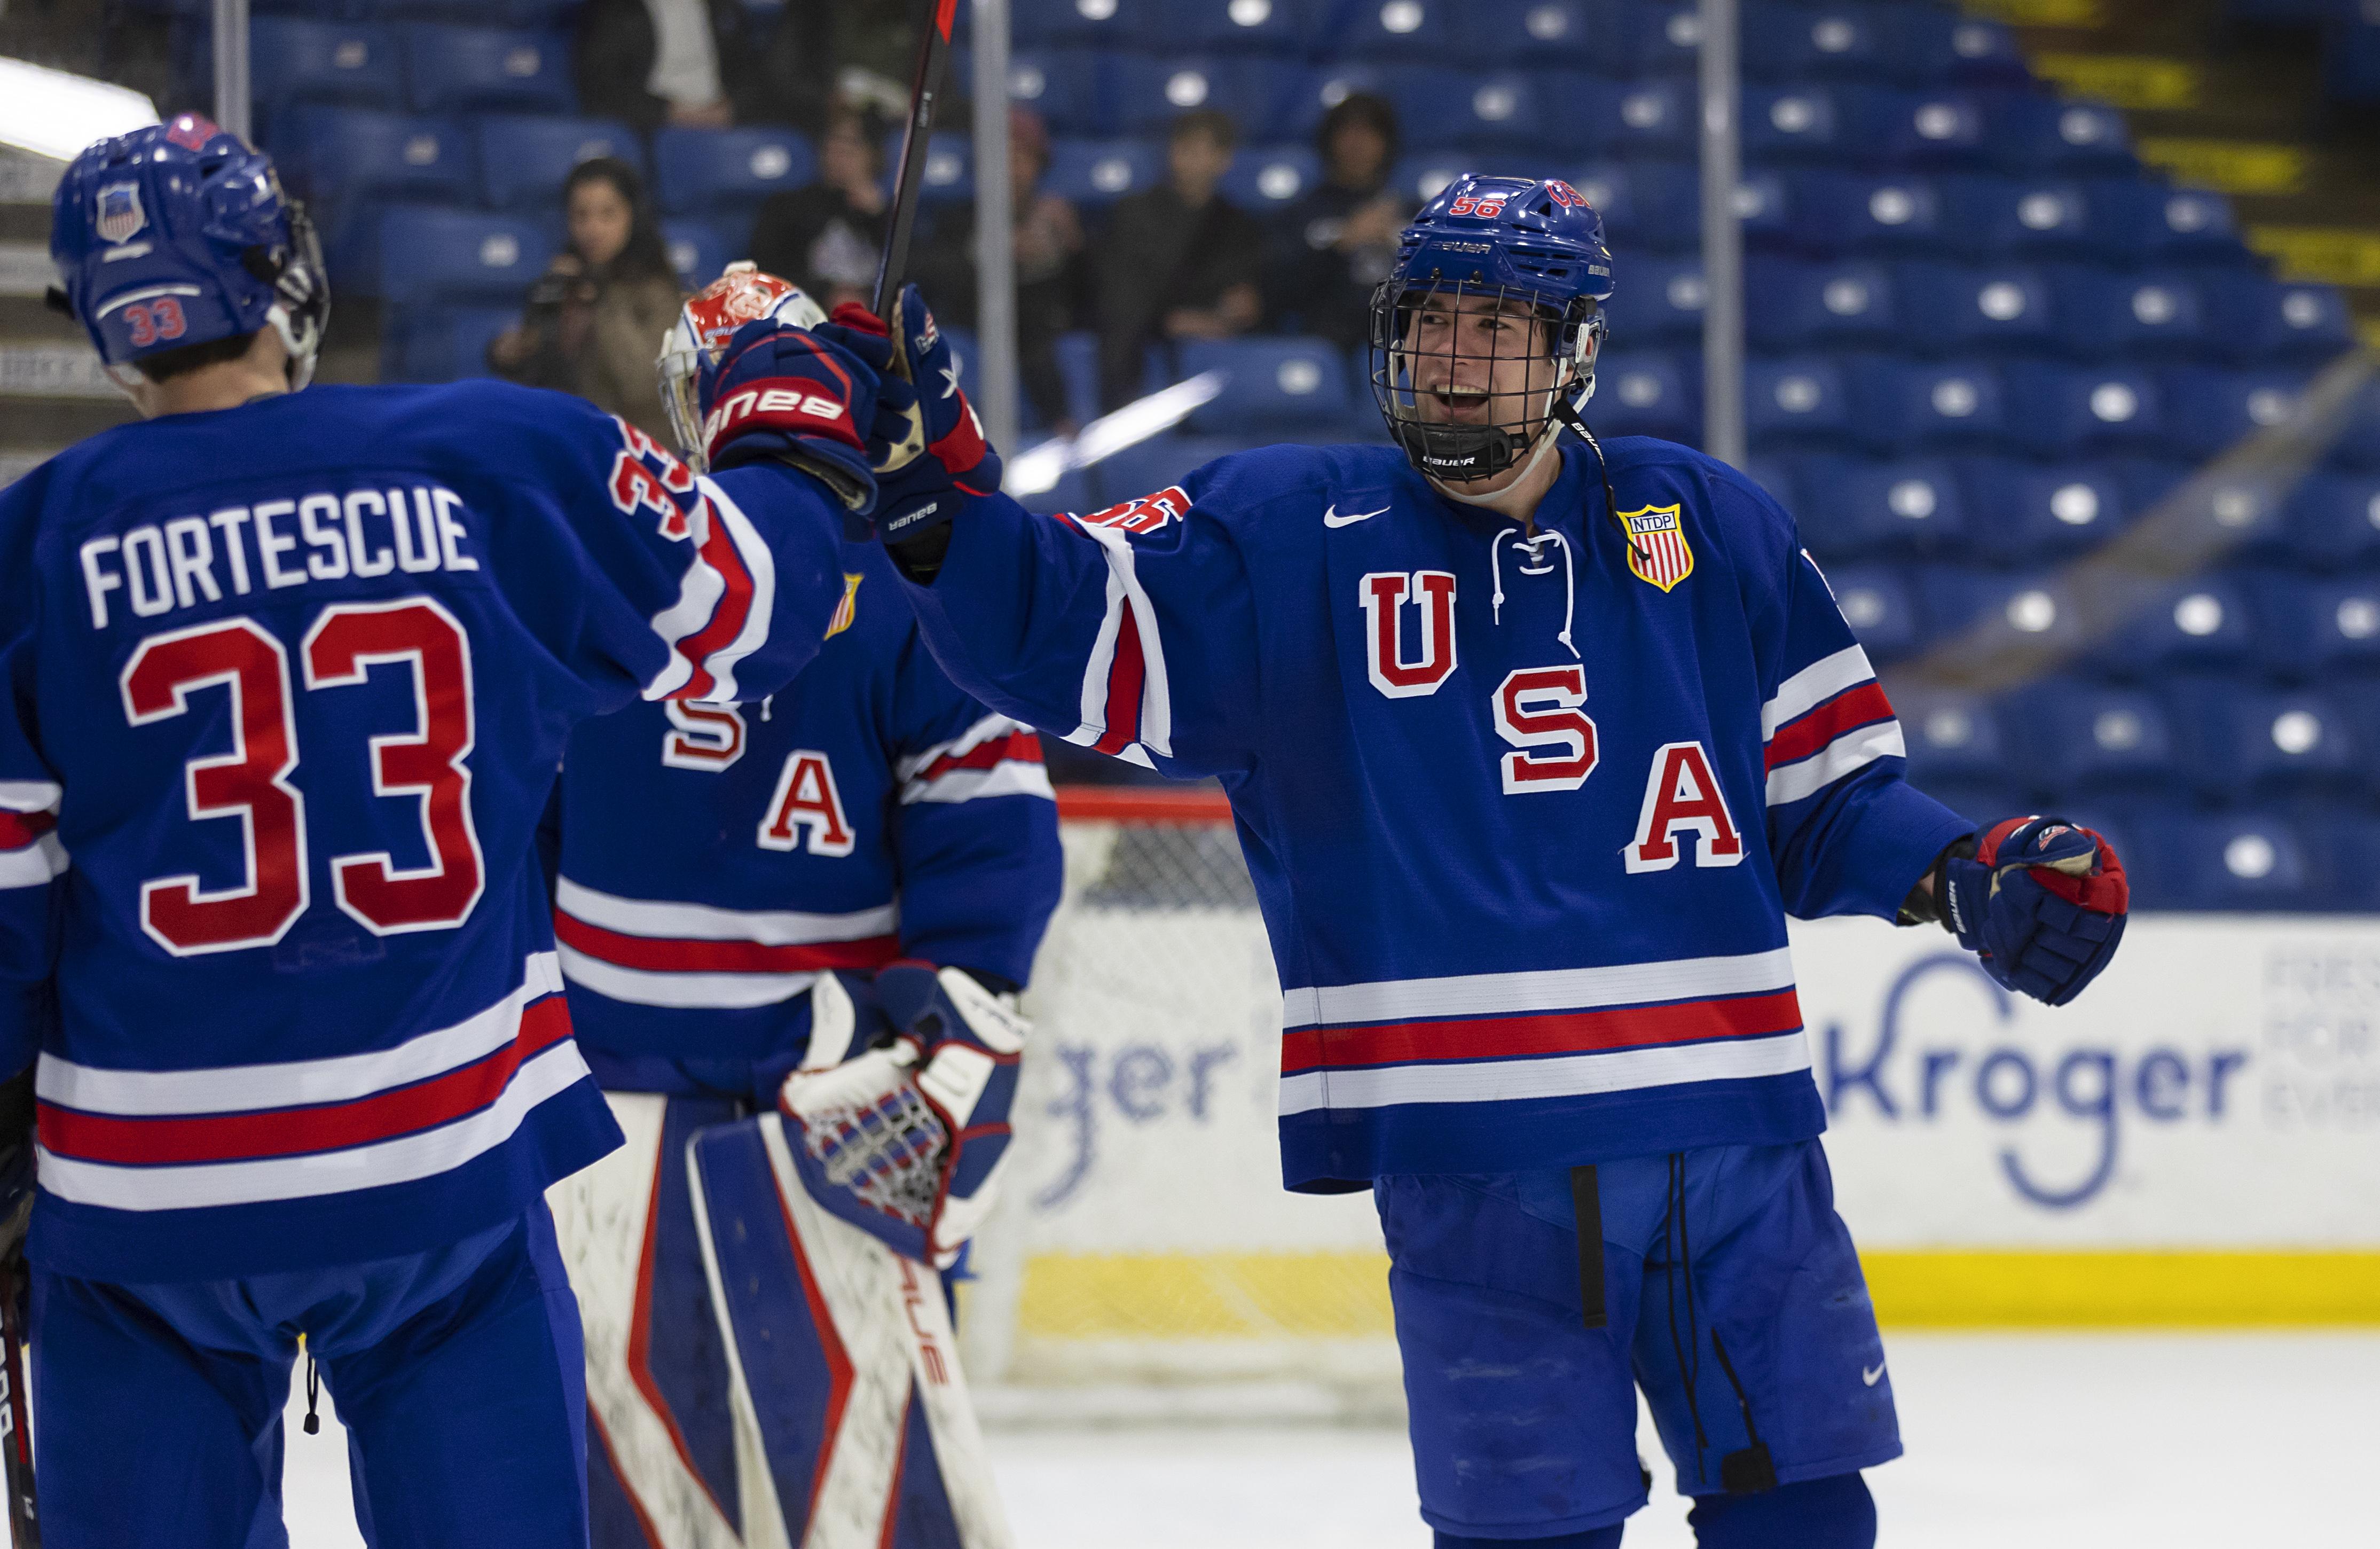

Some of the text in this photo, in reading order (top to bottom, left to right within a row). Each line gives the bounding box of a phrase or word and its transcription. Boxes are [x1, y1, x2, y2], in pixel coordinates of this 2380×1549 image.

[1449, 197, 1506, 218] 56
[123, 298, 187, 347] 33
[80, 487, 480, 629] FORTESCUE
[1633, 515, 1671, 531] NTDP
[120, 596, 485, 956] 33
[1822, 951, 2255, 1214] Kroger
